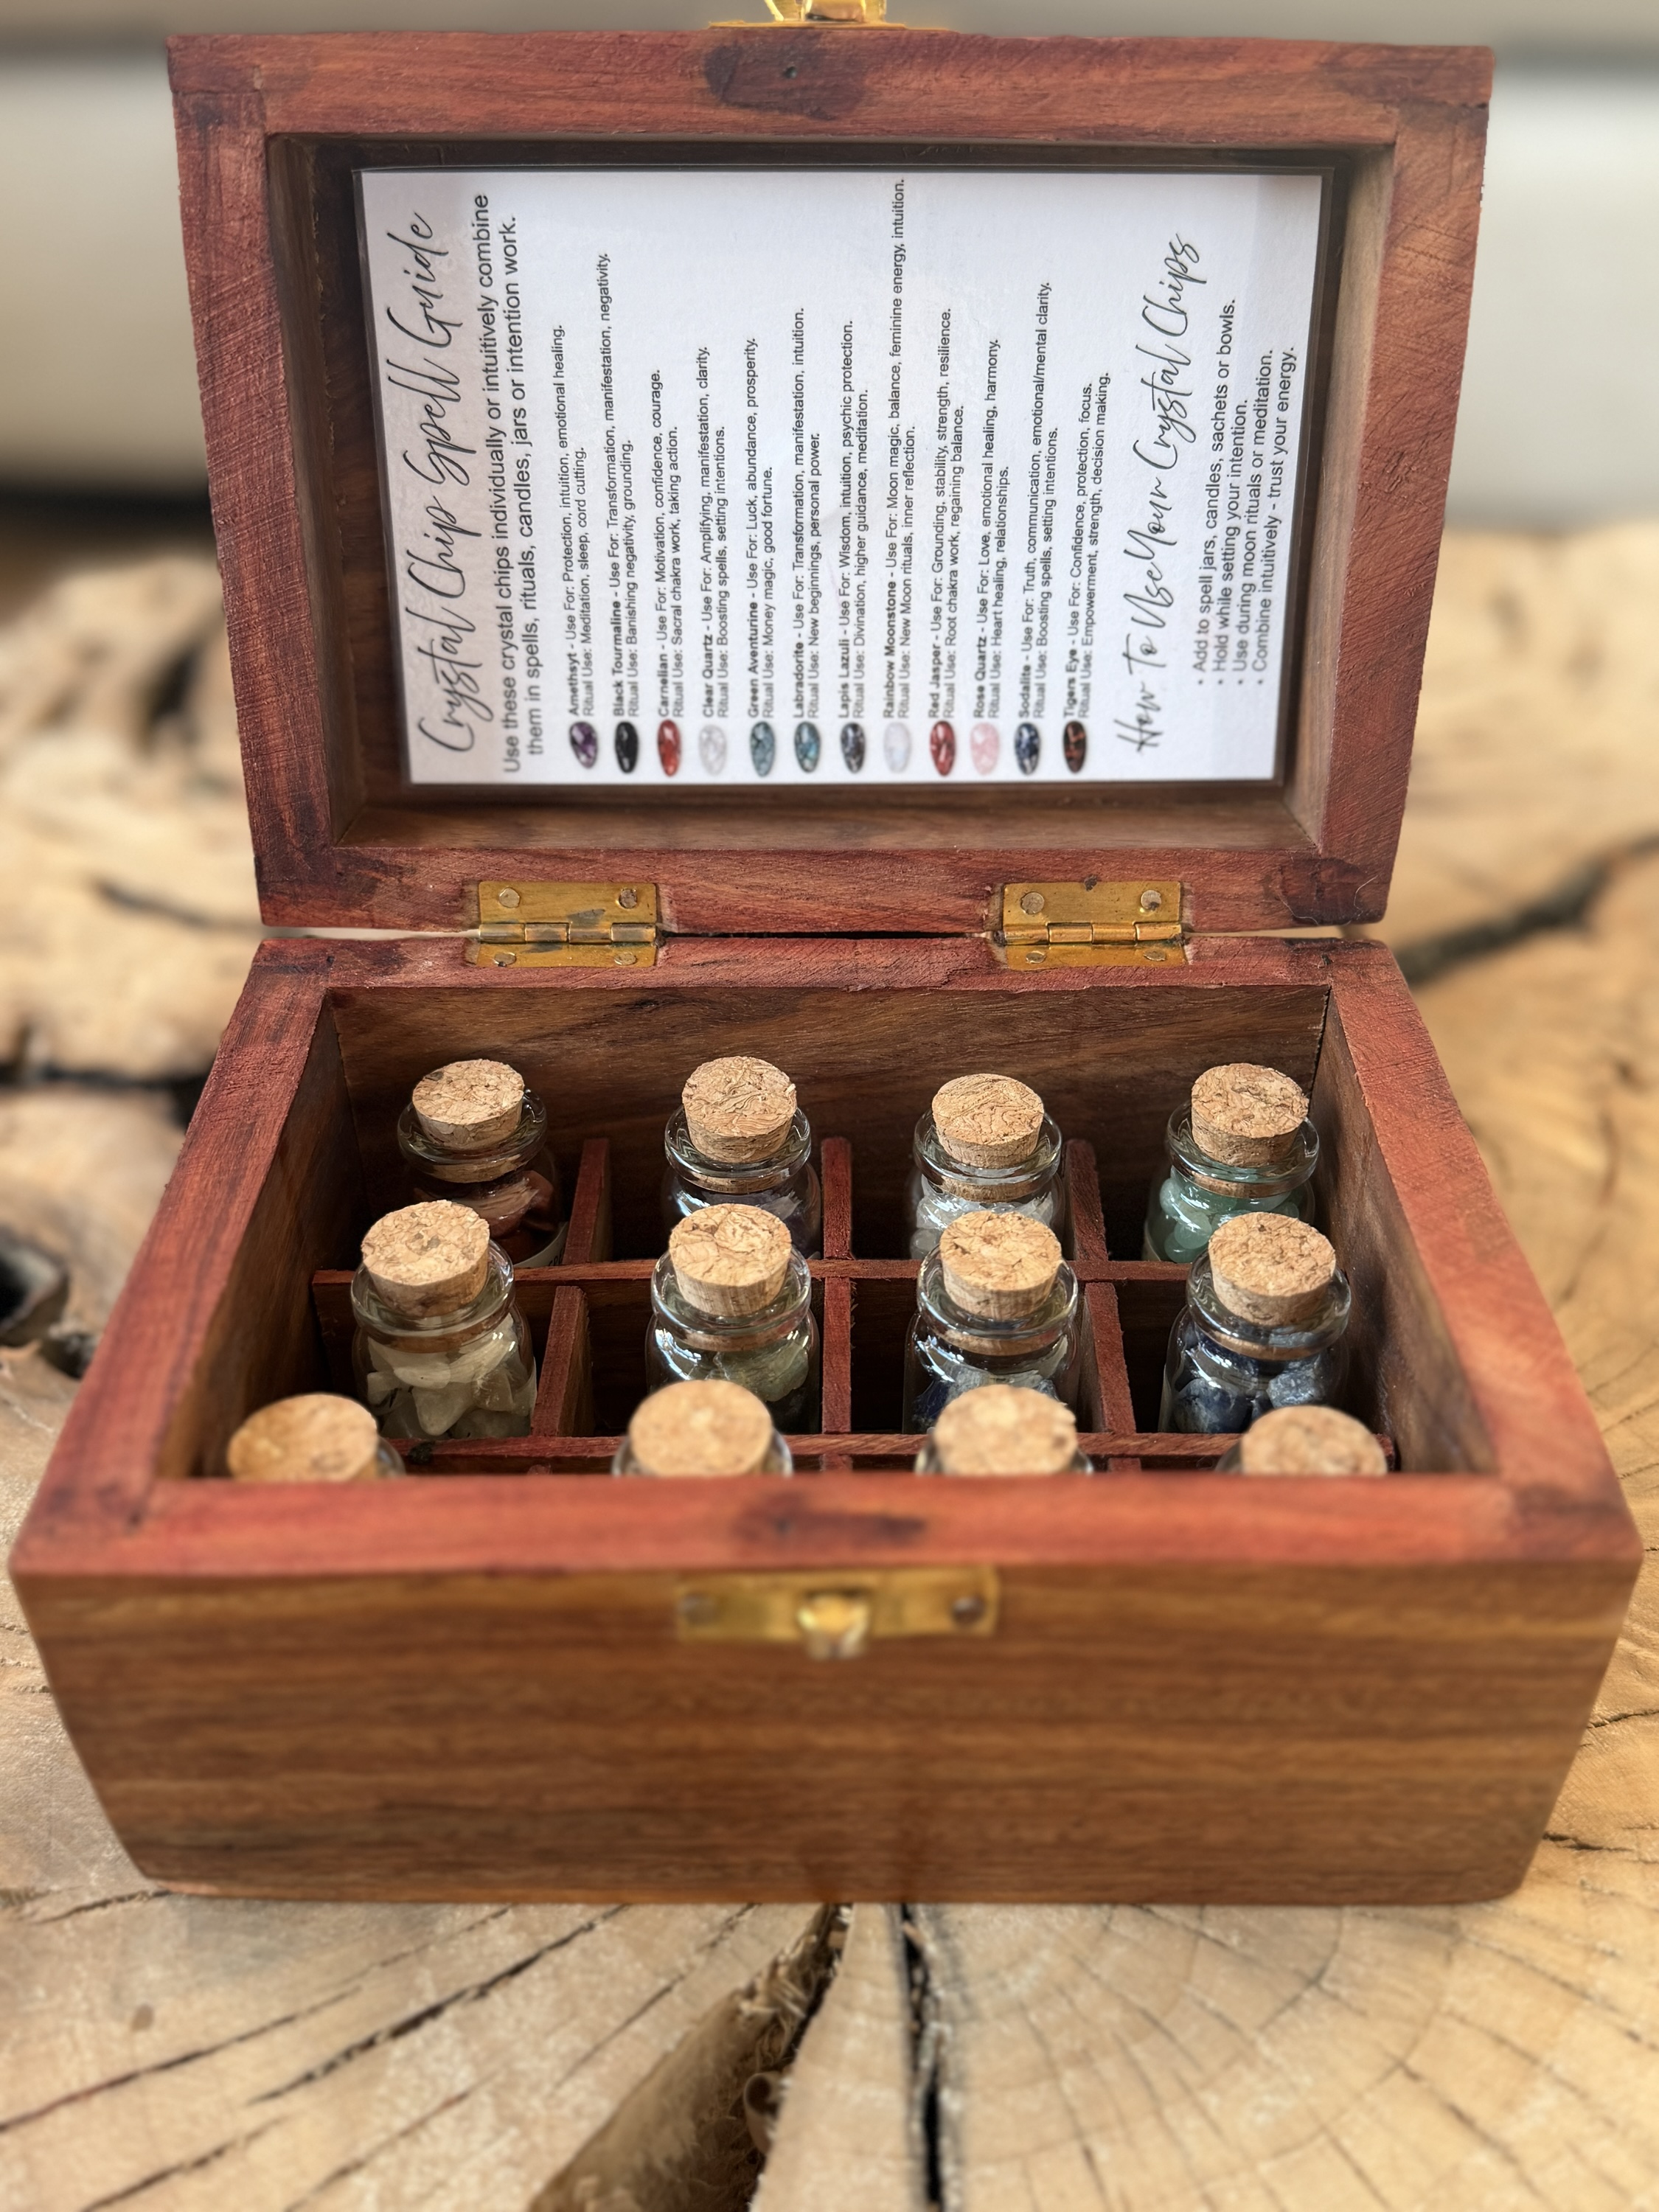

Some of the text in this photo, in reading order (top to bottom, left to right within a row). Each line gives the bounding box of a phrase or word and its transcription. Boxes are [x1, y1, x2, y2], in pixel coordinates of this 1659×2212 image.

[891, 176, 905, 238] intuition.
[595, 252, 613, 321] negativity.
[892, 242, 906, 294] energy,
[888, 297, 902, 358] feminine
[1034, 282, 1051, 325] clarity.
[550, 324, 566, 378] healing.
[791, 307, 804, 365] intuition.
[840, 320, 855, 392] protection.
[936, 307, 951, 377] resilience.
[599, 325, 614, 421] manifestation,
[695, 347, 710, 389] clarity.
[743, 337, 759, 407] prosperity.
[887, 361, 902, 418] balance,
[984, 338, 1001, 401] harmony.
[1031, 328, 1047, 446] emotional/mental
[1276, 346, 1297, 412] energy.
[552, 382, 568, 448] emotional
[650, 369, 664, 428] courage.
[791, 369, 805, 465] manifestation,
[839, 394, 854, 447] psychic
[935, 381, 950, 441] strength,
[1077, 381, 1092, 423] focus.
[696, 393, 710, 487] manifestation,
[744, 411, 758, 490] abundance,
[887, 422, 902, 467] magic,
[981, 404, 998, 458] healing,
[1273, 416, 1288, 456] your
[385, 212, 493, 752] Crystal Chip Spell Guide
[470, 194, 521, 773] Use these crystal chips individually or intuitively combine
[498, 215, 543, 755] them in spells, rituals, candles, jars or intention work.
[557, 453, 571, 508] intuition,
[602, 425, 618, 529] Transformation,
[650, 432, 664, 508] confidence,
[838, 451, 853, 508] intuition,
[933, 444, 949, 497] stability,
[1075, 427, 1091, 496] protection,
[1192, 298, 1235, 672] Add to spell jars, candles, sachets or bowls.
[1266, 459, 1284, 498] trust
[745, 495, 758, 529] Luck,
[886, 471, 899, 508] Moon
[980, 462, 993, 526] emotional
[1026, 450, 1042, 554] communication,
[1113, 232, 1207, 753] How To Use Your Crystal Chips
[1231, 349, 1273, 672] Use during moon rituals or meditation.
[560, 512, 574, 582] Protection,
[606, 532, 619, 557] For:
[653, 512, 666, 582] Motivation,
[698, 491, 714, 563] Amplifying,
[745, 534, 757, 559] For:
[791, 470, 805, 571] Transformation,
[838, 511, 852, 568] Wisdom,
[885, 512, 897, 538] For:
[931, 500, 947, 573] Grounding,
[977, 530, 992, 565] Love,
[1069, 499, 1087, 578] Confidence,
[1211, 398, 1248, 672] Hold while setting your intention.
[608, 561, 620, 587] Use
[699, 567, 712, 592] For:
[745, 562, 758, 588] Use
[885, 541, 897, 568] Use
[1022, 557, 1037, 594] Truth,
[1257, 514, 1282, 592] intuitively
[563, 585, 575, 611] For:
[654, 586, 667, 611] For:
[791, 574, 804, 599] For:
[837, 571, 850, 597] For:
[930, 577, 942, 602] For:
[976, 568, 989, 594] For:
[1068, 581, 1081, 607] For:
[564, 613, 577, 639] Use
[655, 614, 667, 641] Use
[700, 595, 712, 622] Use
[792, 602, 804, 629] Use
[838, 599, 850, 626] Use
[883, 580, 897, 657] Moonstone
[929, 605, 942, 631] Use
[975, 597, 989, 623] Use
[1021, 598, 1034, 622] For:
[1066, 610, 1079, 636] Use
[1251, 597, 1272, 672] Combine
[609, 599, 623, 676] Tourmaline
[700, 633, 714, 680] Quartz
[746, 600, 759, 675] Aventurine
[838, 637, 850, 678] Lazuli
[973, 635, 987, 682] Quartz
[1020, 625, 1033, 652] Use
[1064, 647, 1080, 673] Eye
[655, 653, 669, 717] Carnelian
[792, 641, 804, 718] Labradorite
[882, 659, 895, 718] Rainbow
[928, 642, 943, 689] Jasper
[1018, 663, 1032, 718] Sodalite
[611, 679, 625, 717] Black
[701, 682, 714, 718] Clear
[746, 678, 759, 718] Green
[837, 681, 852, 718] Lapis
[928, 692, 940, 718] Red
[972, 684, 986, 718] Rose
[1062, 676, 1078, 718] Tigers
